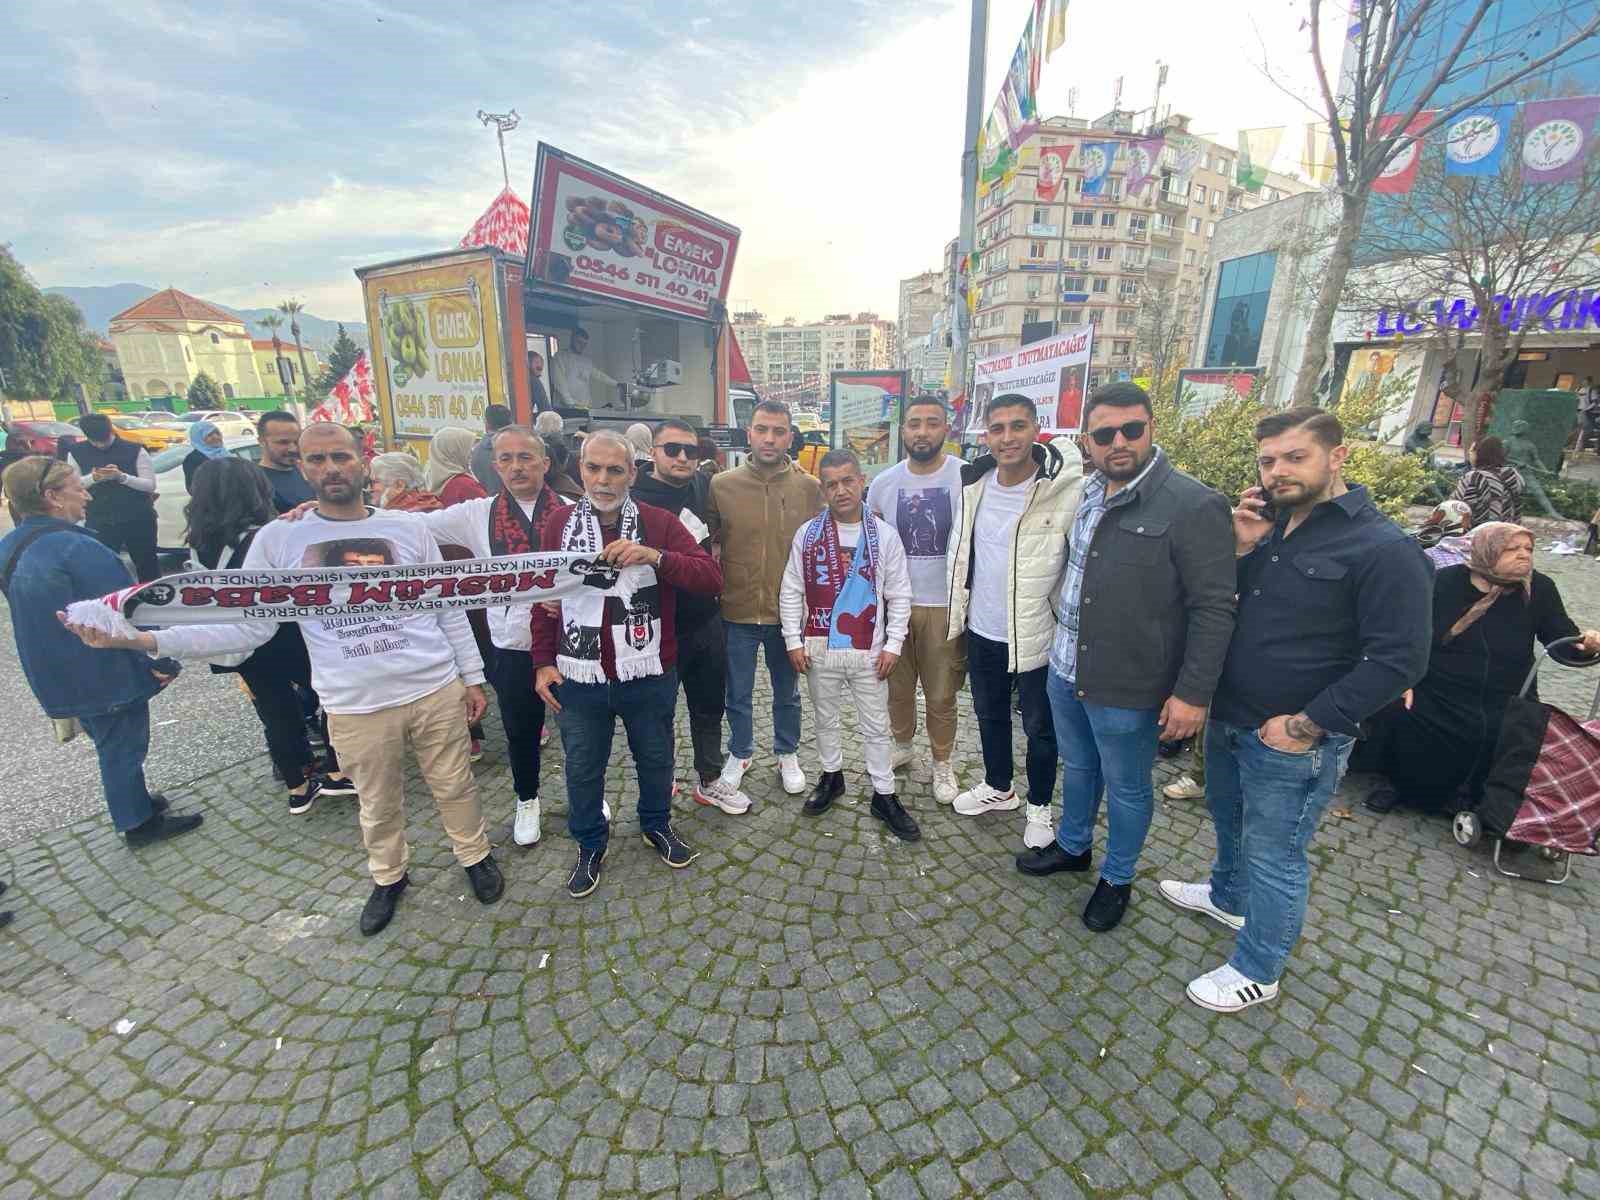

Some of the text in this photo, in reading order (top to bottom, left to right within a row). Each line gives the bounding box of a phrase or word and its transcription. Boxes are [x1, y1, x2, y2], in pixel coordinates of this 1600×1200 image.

[663, 231, 714, 265] EMEK
[576, 254, 629, 281] 0546
[635, 271, 660, 289] 511
[665, 281, 689, 297] 40
[692, 288, 709, 301] 41
[652, 251, 716, 287] LOKMA
[435, 311, 476, 341] EMEK
[435, 351, 485, 382] LOKMA
[181, 574, 215, 586] UYU
[347, 570, 391, 581] BABA
[243, 607, 310, 619] DERKEN
[399, 599, 442, 612] BEYAZ
[447, 597, 488, 608] SANA
